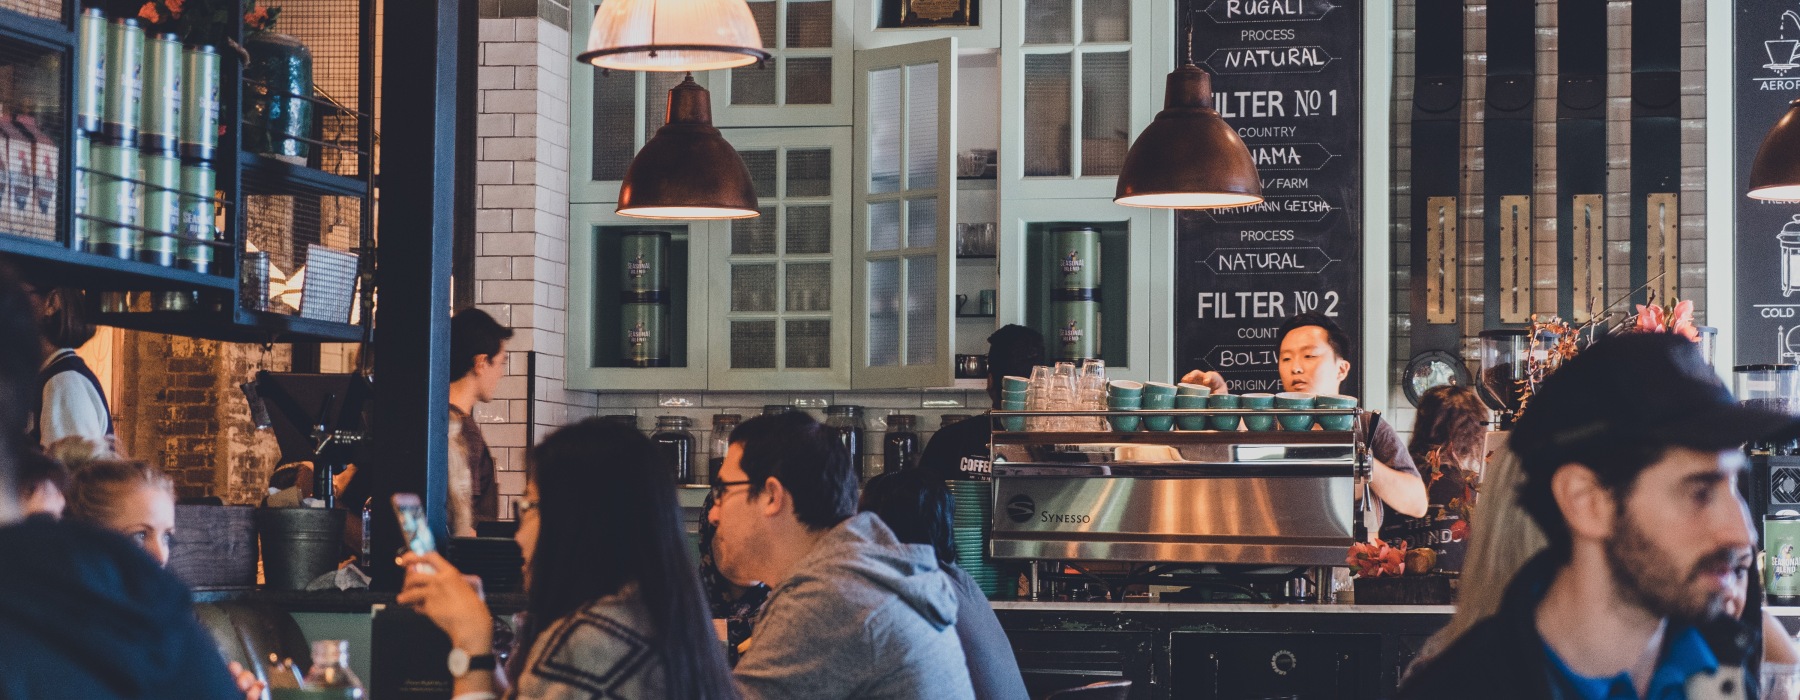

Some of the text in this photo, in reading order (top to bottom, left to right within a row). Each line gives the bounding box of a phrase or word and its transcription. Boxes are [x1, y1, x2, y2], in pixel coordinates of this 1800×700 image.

[1241, 29, 1295, 41] PROCESS
[1225, 48, 1325, 68] NATURAL
[1211, 90, 1285, 118] ILTER
[1329, 89, 1337, 116] 1
[1238, 126, 1297, 138] COUNTRY
[1250, 147, 1301, 165] NAMA
[1284, 200, 1330, 212] GEISHA
[1240, 230, 1295, 242] PROCESS
[1218, 253, 1305, 271] NATURAL
[1197, 291, 1286, 319] FILTER
[1324, 290, 1339, 317] 2
[1761, 307, 1795, 318] COLD
[1237, 327, 1279, 339] COUNT
[1226, 379, 1284, 391] ORIGIN/F
[1771, 556, 1800, 566] SEASONA
